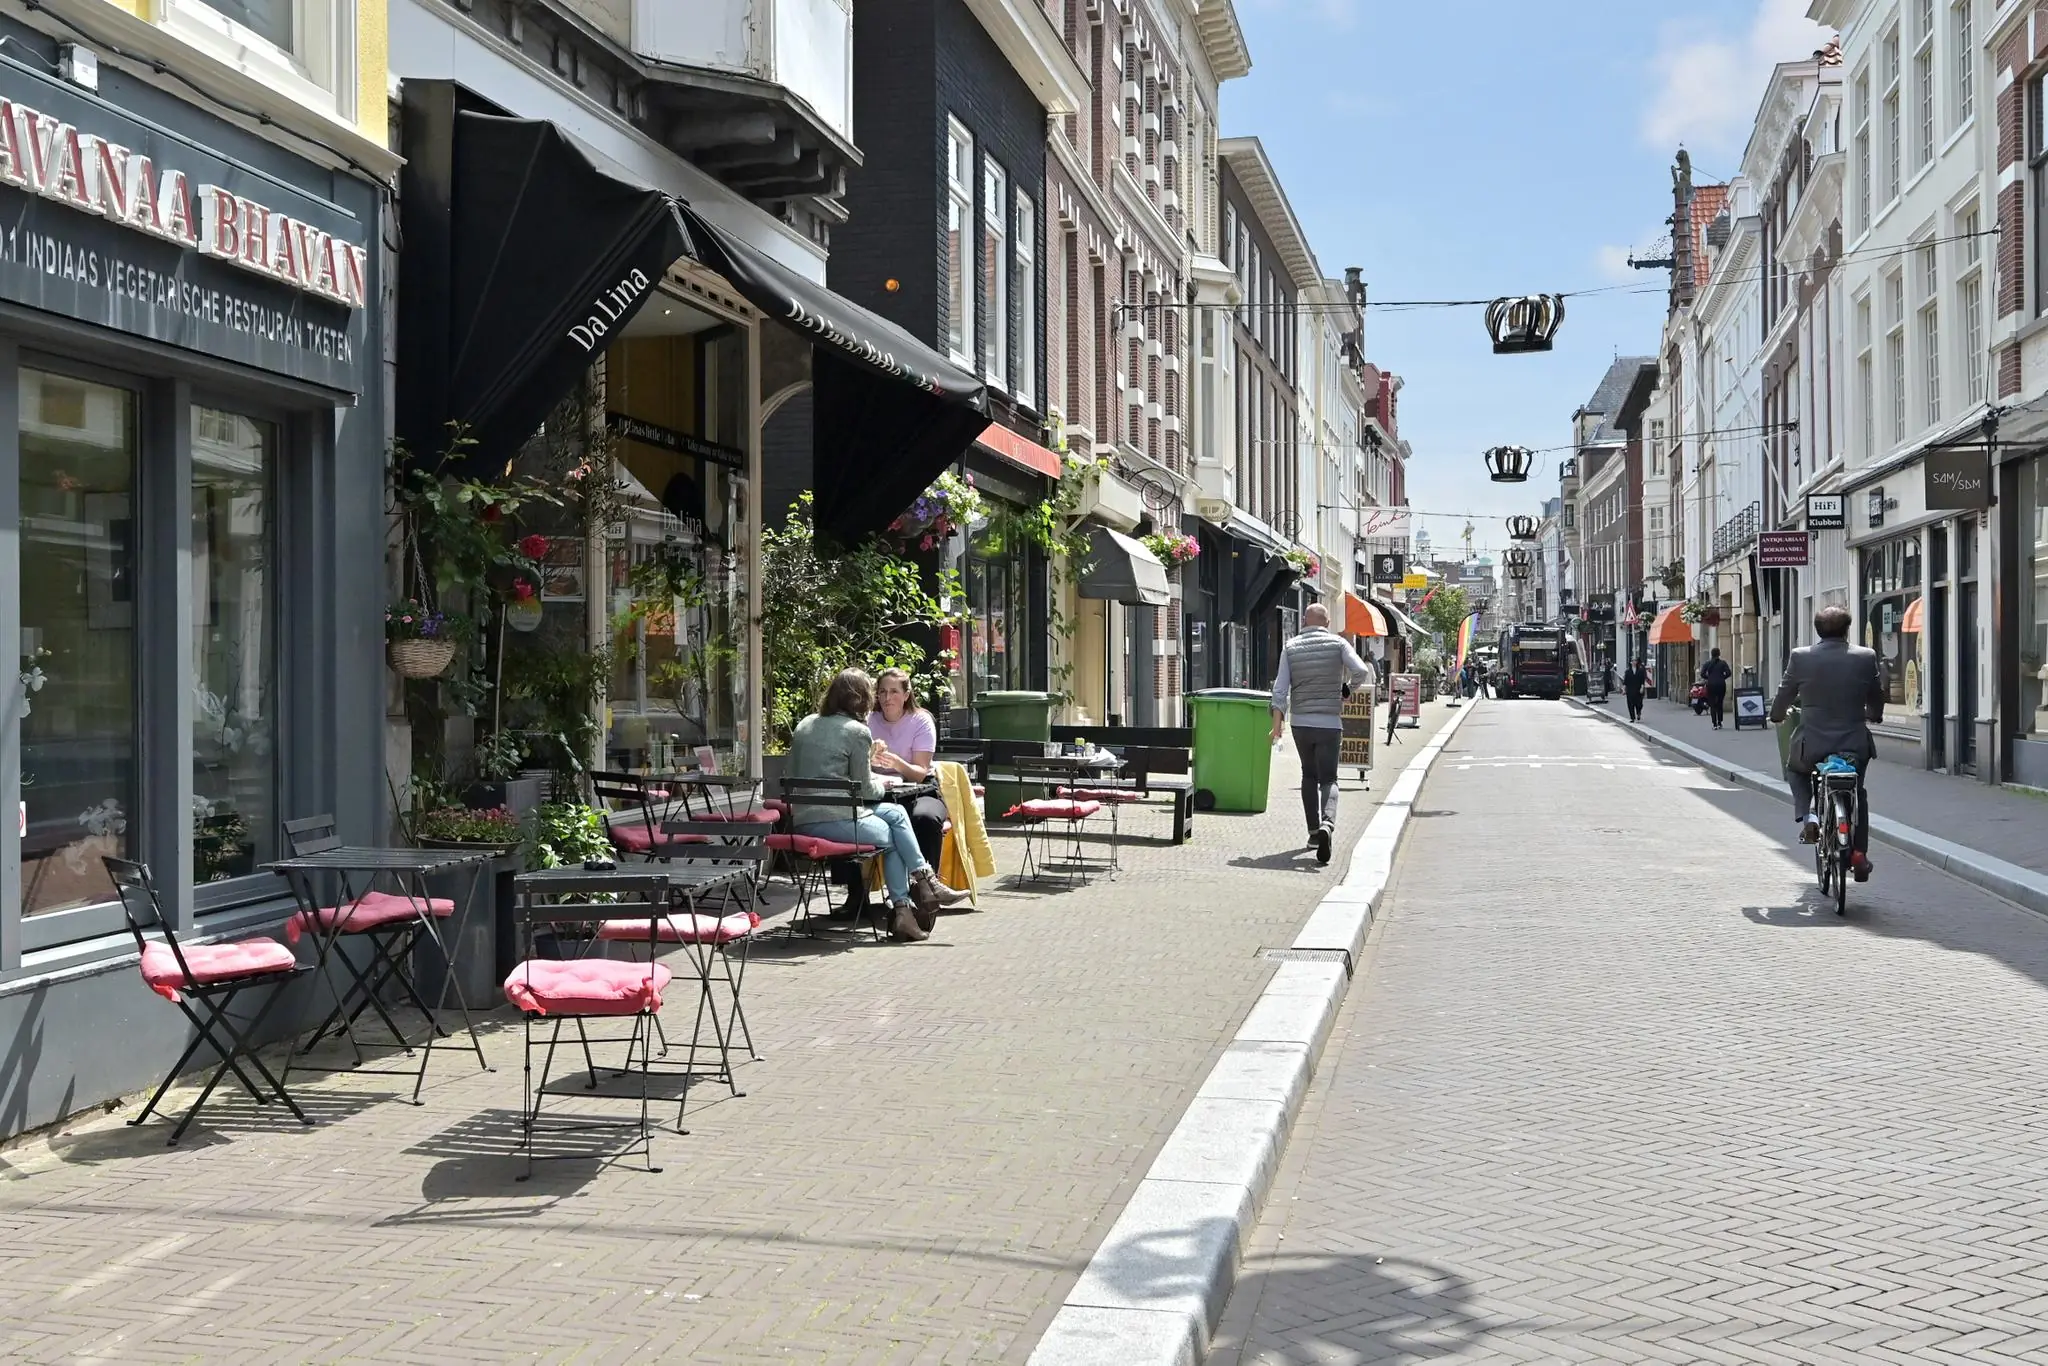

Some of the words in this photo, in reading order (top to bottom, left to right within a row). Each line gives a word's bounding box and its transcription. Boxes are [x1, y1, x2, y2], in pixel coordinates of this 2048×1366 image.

[26, 230, 99, 288] INDIAAS
[104, 256, 220, 324] VEGETARISCHE
[225, 294, 302, 347] RESTAURAN
[200, 184, 367, 308] BHAVAN
[566, 315, 609, 352] Da
[593, 267, 650, 322] Lina
[1809, 518, 1842, 526] Klubben
[1815, 501, 1836, 510] HiFi
